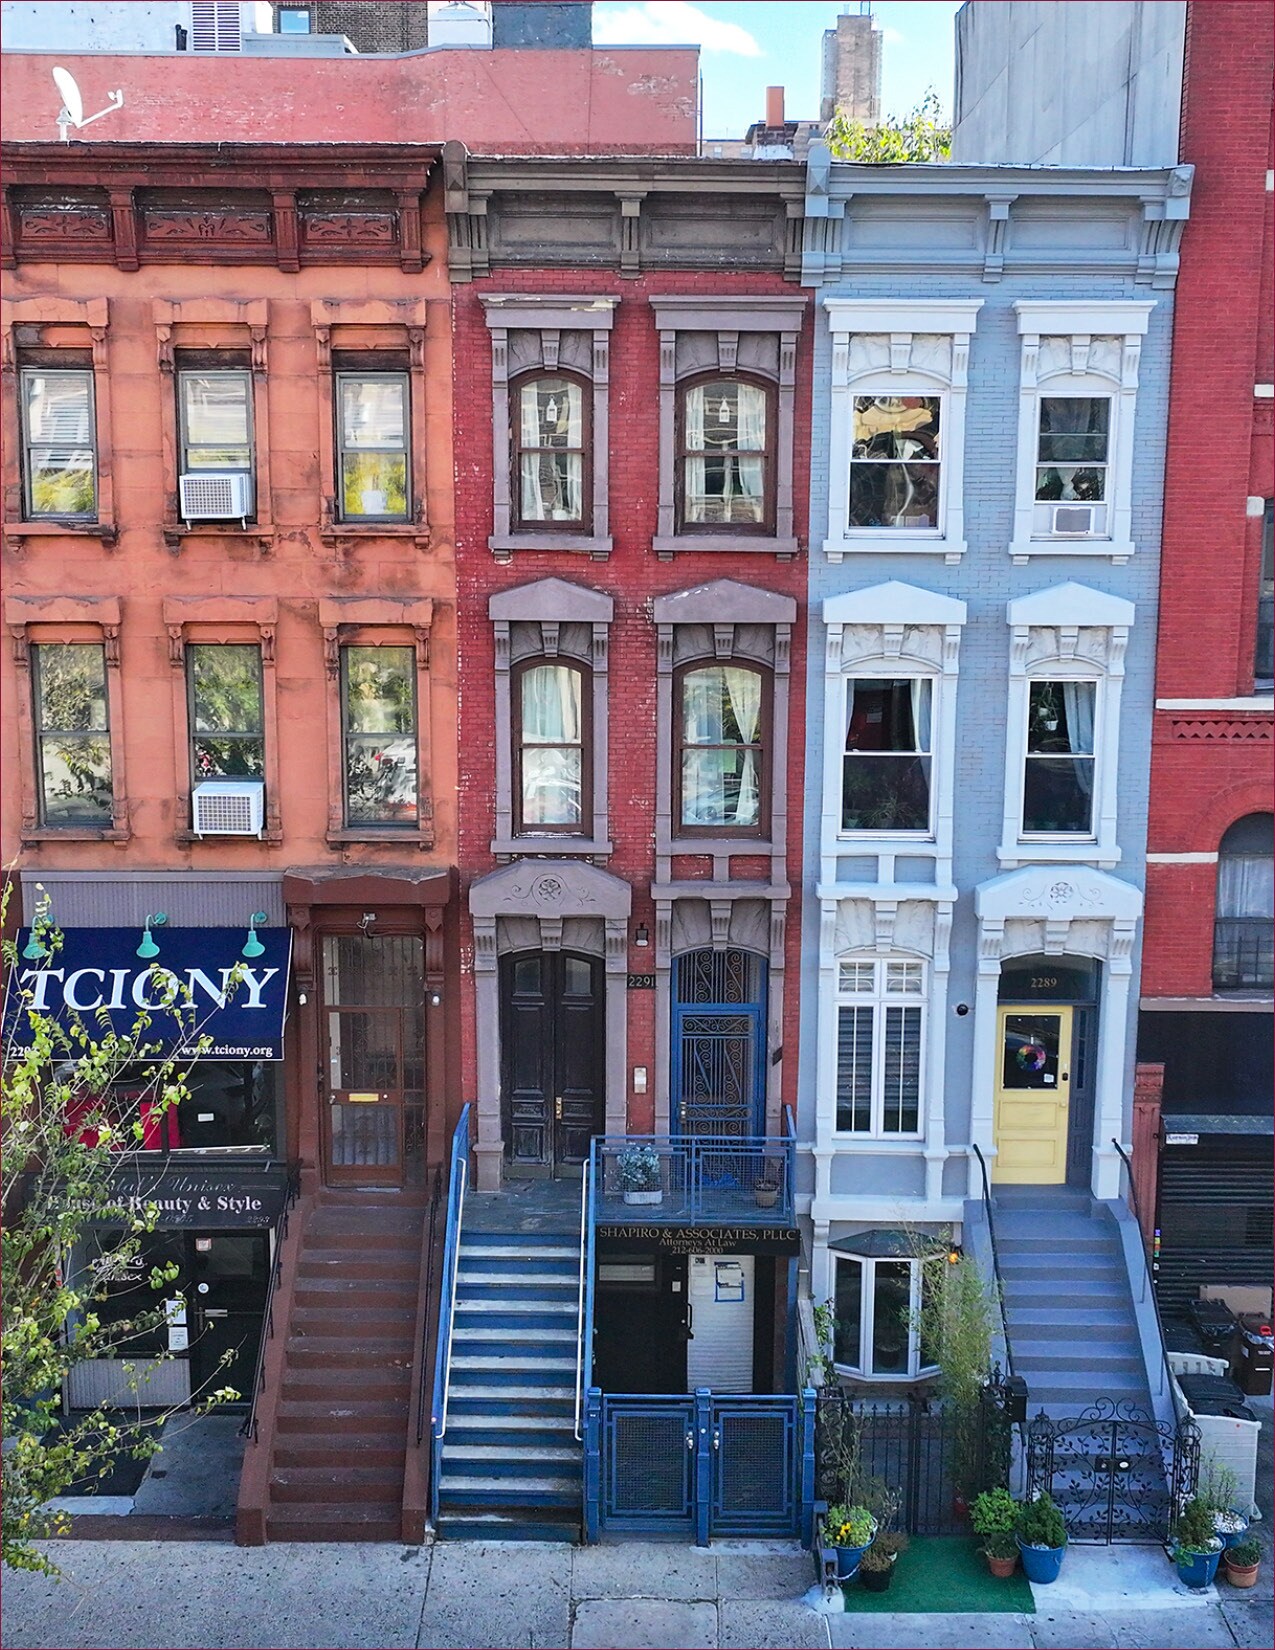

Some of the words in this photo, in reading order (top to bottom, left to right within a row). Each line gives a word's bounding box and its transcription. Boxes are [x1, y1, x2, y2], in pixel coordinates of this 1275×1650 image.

[629, 976, 654, 987] 2291
[1031, 978, 1057, 988] 2289
[20, 968, 279, 1010] TCIONY
[181, 1044, 273, 1058] www.tciony.org
[106, 1195, 124, 1210] of
[197, 1195, 211, 1211] &
[217, 1195, 262, 1214] Style
[600, 1227, 660, 1238] SHAPIRO
[662, 1228, 673, 1239] &
[676, 1229, 759, 1241] ASSOCIATES,
[763, 1230, 796, 1240] PLLC
[659, 1238, 702, 1247] Attorneys
[704, 1239, 716, 1247] At
[719, 1239, 737, 1247] Law
